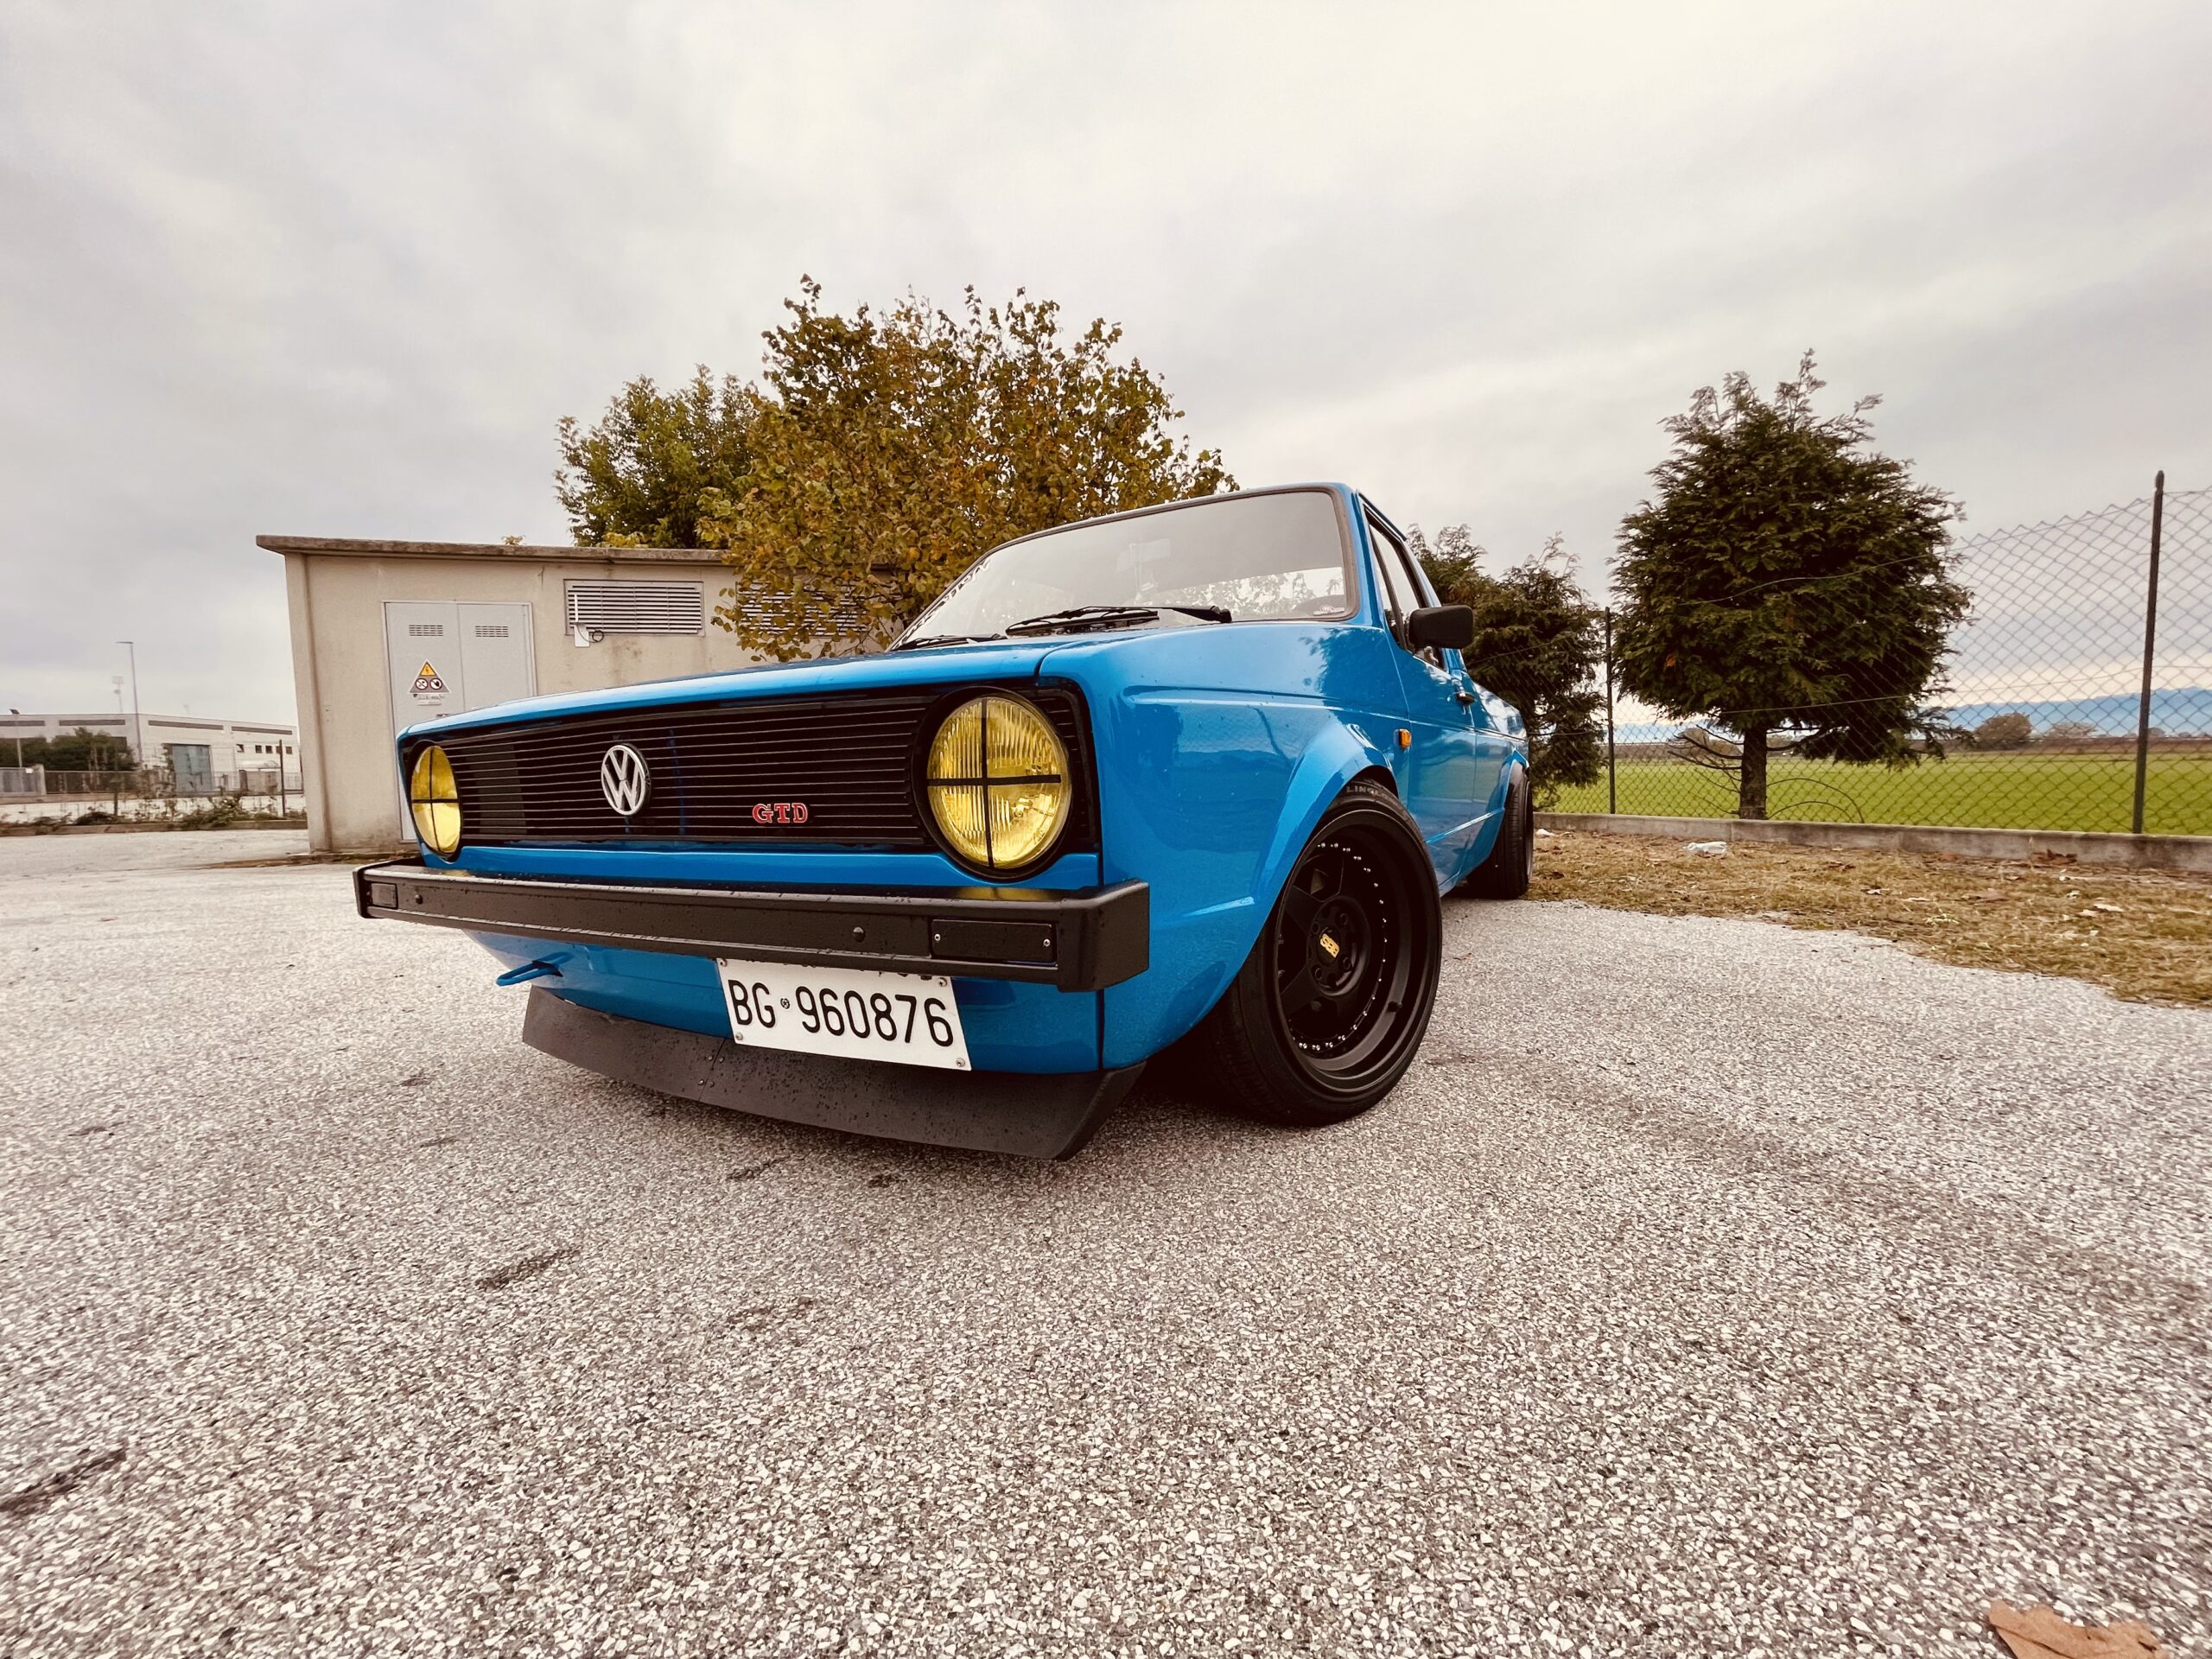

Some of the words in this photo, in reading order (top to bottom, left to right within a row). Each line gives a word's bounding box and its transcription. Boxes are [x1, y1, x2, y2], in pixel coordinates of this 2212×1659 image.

[601, 745, 646, 815] VW
[752, 803, 809, 823] GTD
[728, 979, 776, 1028] BG
[795, 986, 954, 1046] 960876
